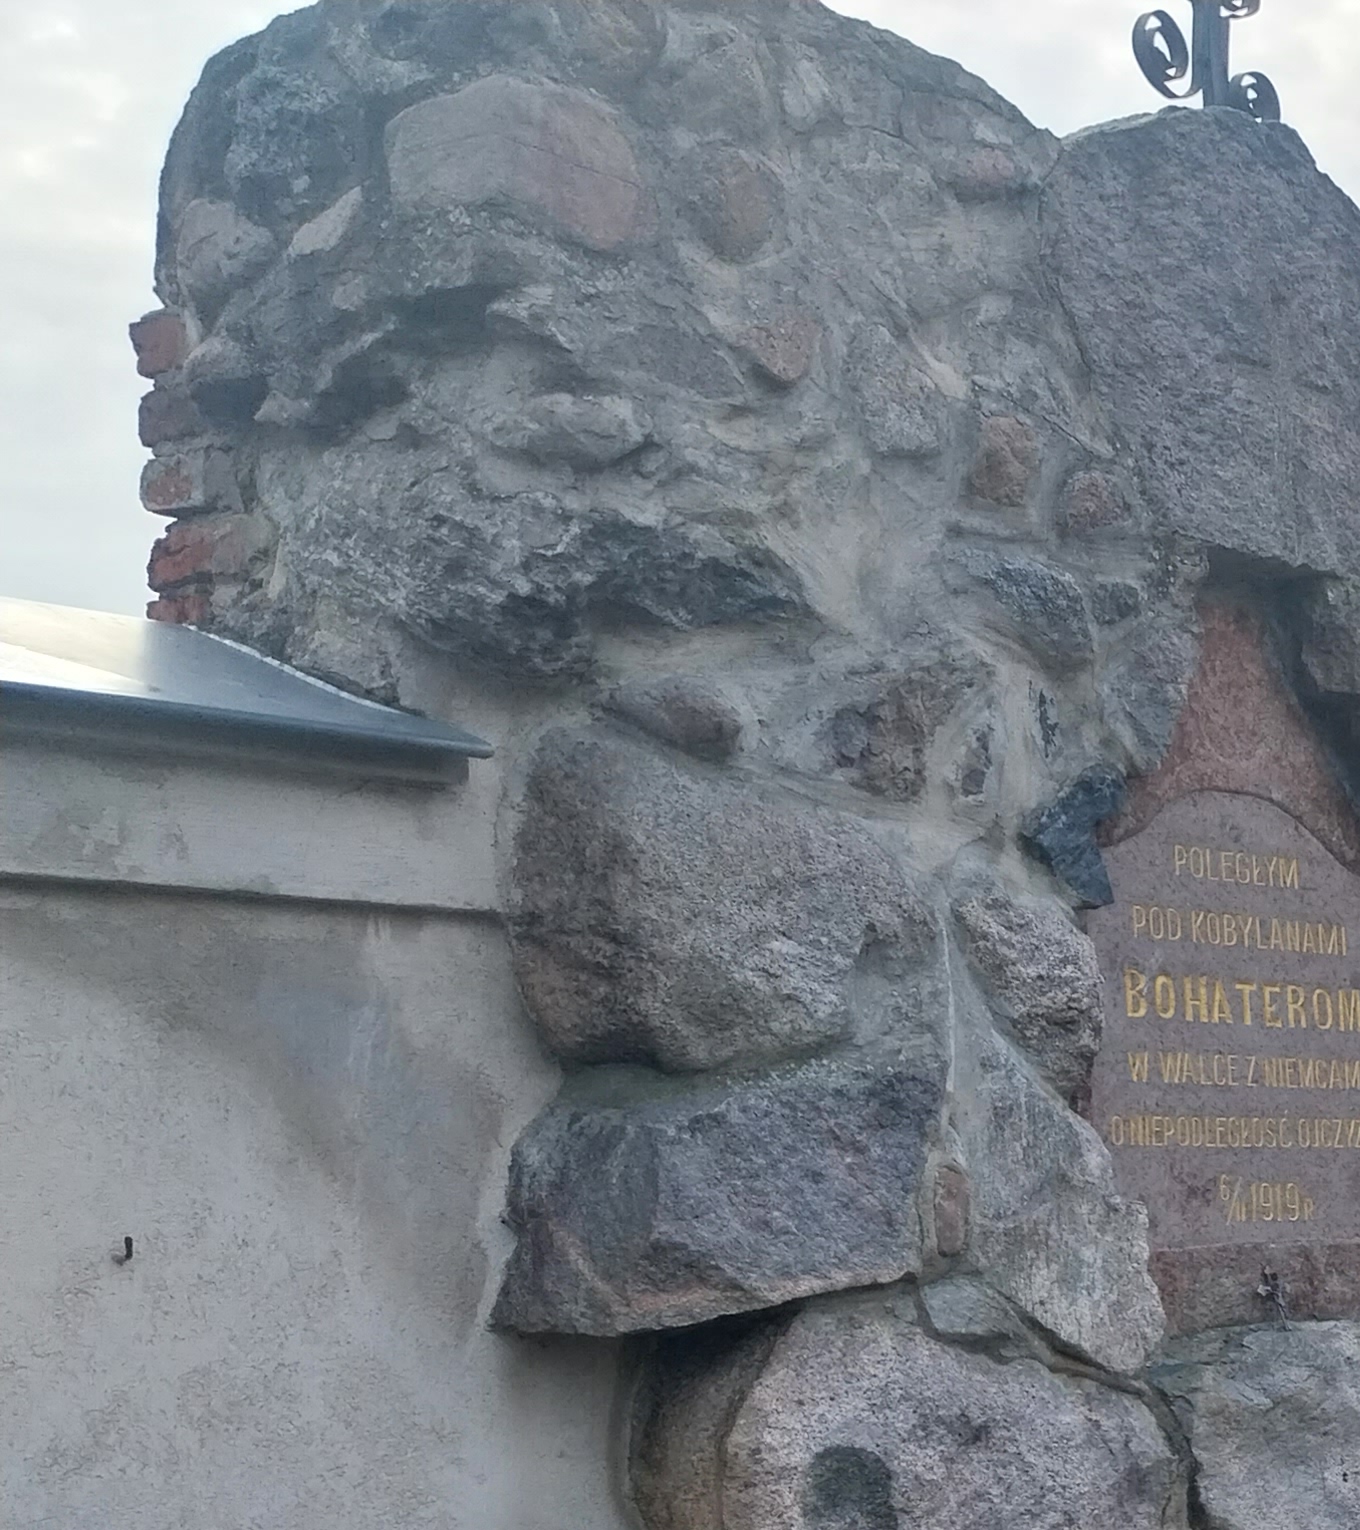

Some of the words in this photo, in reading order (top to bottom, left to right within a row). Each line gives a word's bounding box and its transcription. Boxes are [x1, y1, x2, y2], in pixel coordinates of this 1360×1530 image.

[1174, 845, 1299, 889] POLEGŁYM
[1133, 905, 1182, 940] POD
[1191, 910, 1347, 956] KOBYLANAMI
[1127, 1052, 1149, 1082] W
[1160, 1052, 1239, 1086] WALCE
[1246, 1055, 1257, 1086] Z
[1111, 1115, 1124, 1146] O
[1250, 1181, 1299, 1221] 1919
